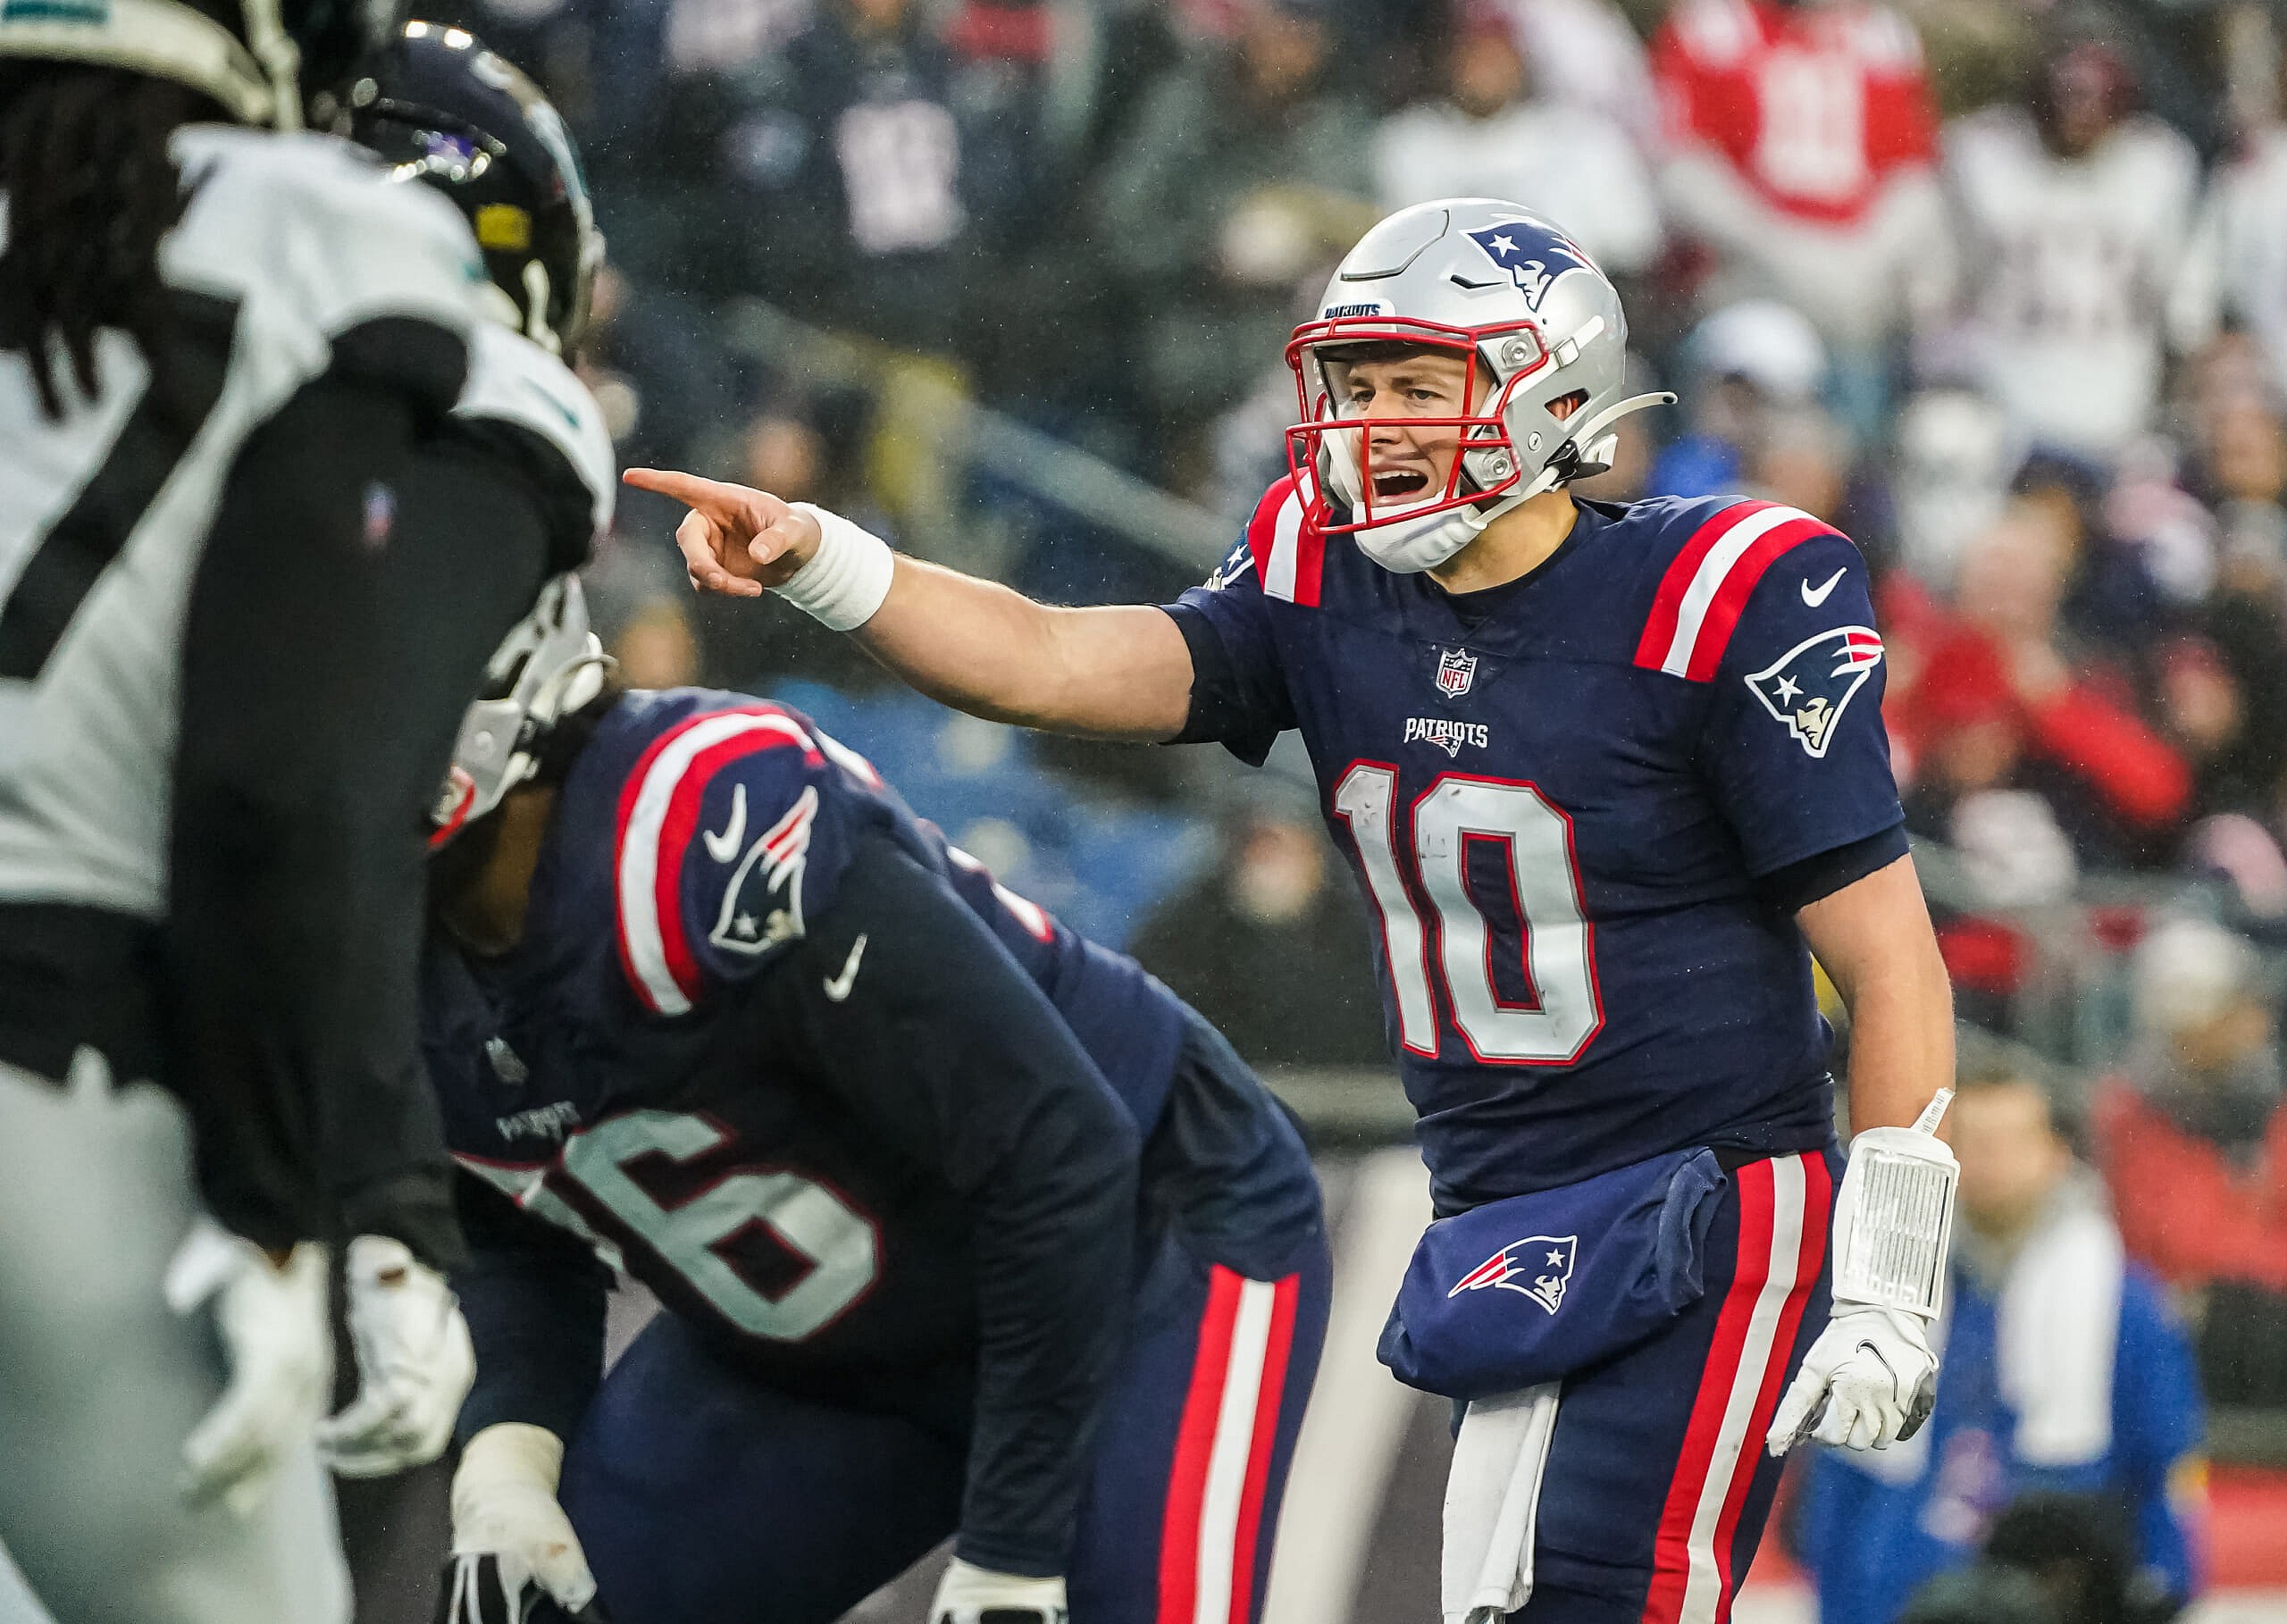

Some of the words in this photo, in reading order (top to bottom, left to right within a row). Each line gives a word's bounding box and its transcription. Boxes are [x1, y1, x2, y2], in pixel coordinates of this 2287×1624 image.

[1442, 669, 1466, 689] NFL
[1403, 717, 1488, 749] PATRIOTS
[1333, 758, 1606, 1067] 10
